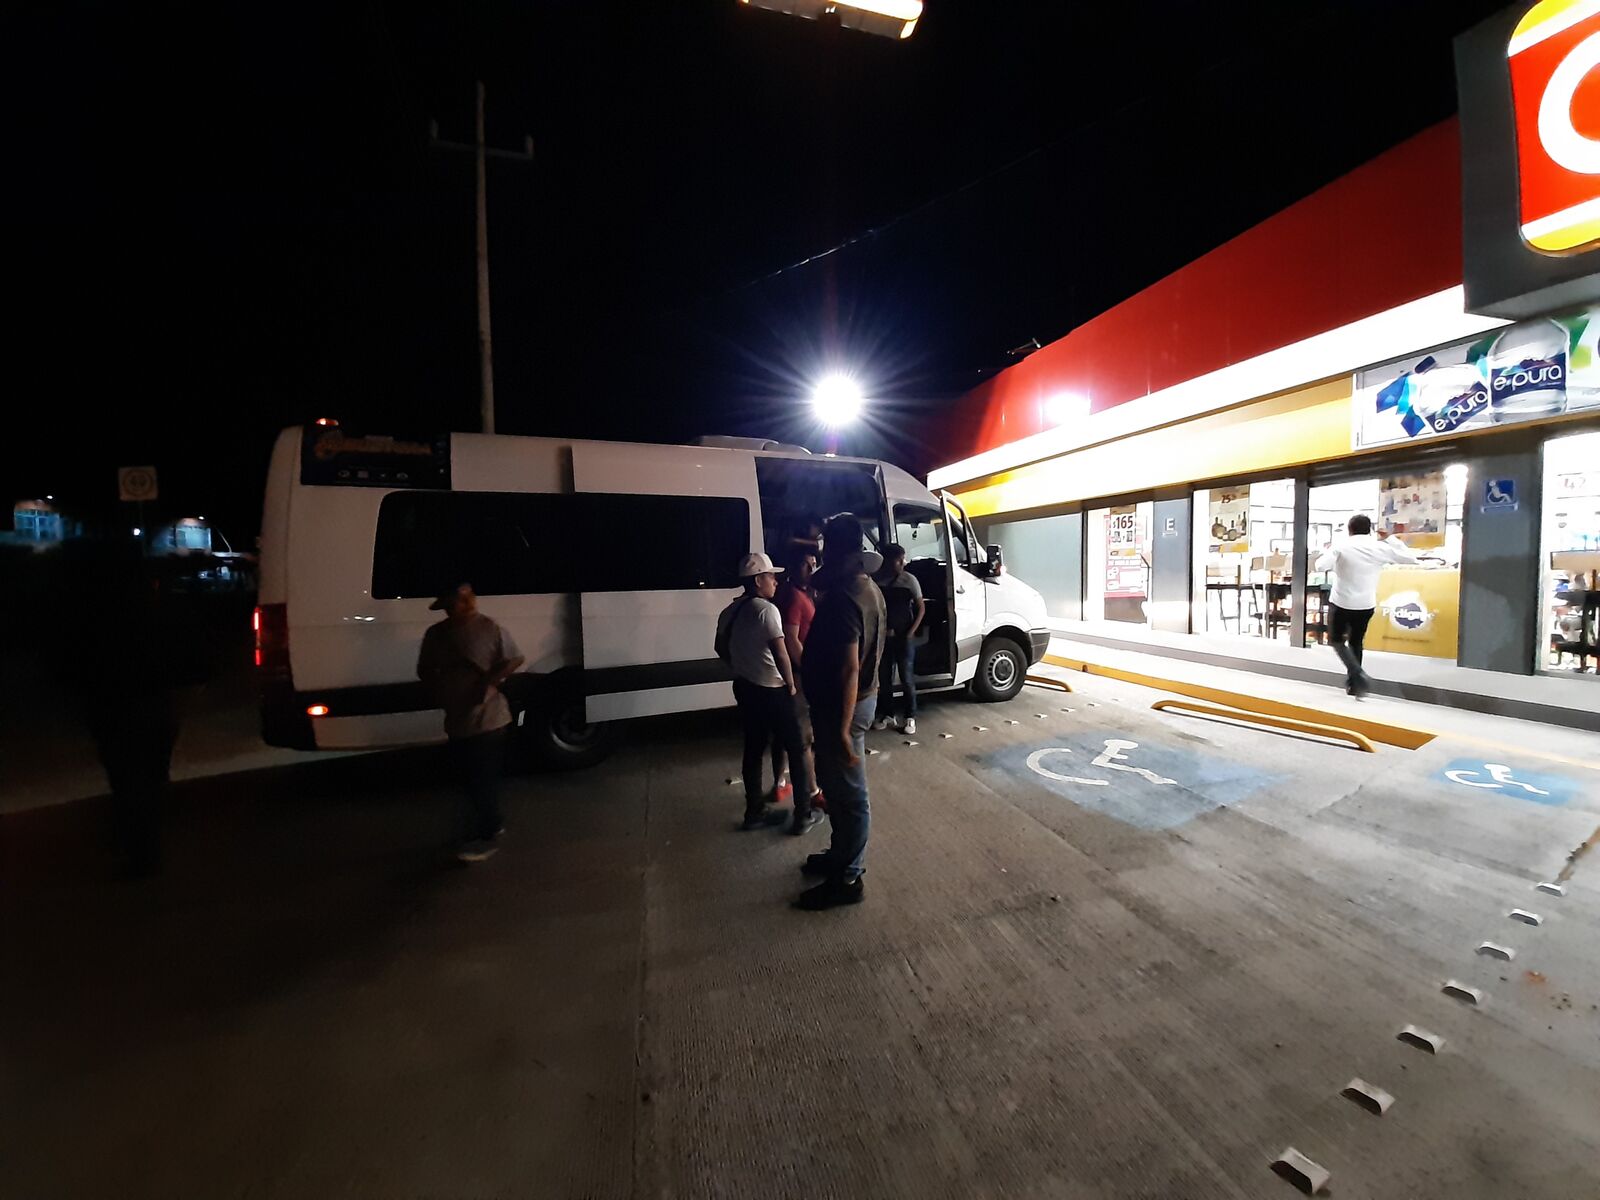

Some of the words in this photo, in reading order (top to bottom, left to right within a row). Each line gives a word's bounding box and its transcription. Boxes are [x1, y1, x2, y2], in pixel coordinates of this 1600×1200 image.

[1112, 515, 1133, 529] $165
[1165, 518, 1175, 531] E
[1382, 607, 1435, 623] Pdige
